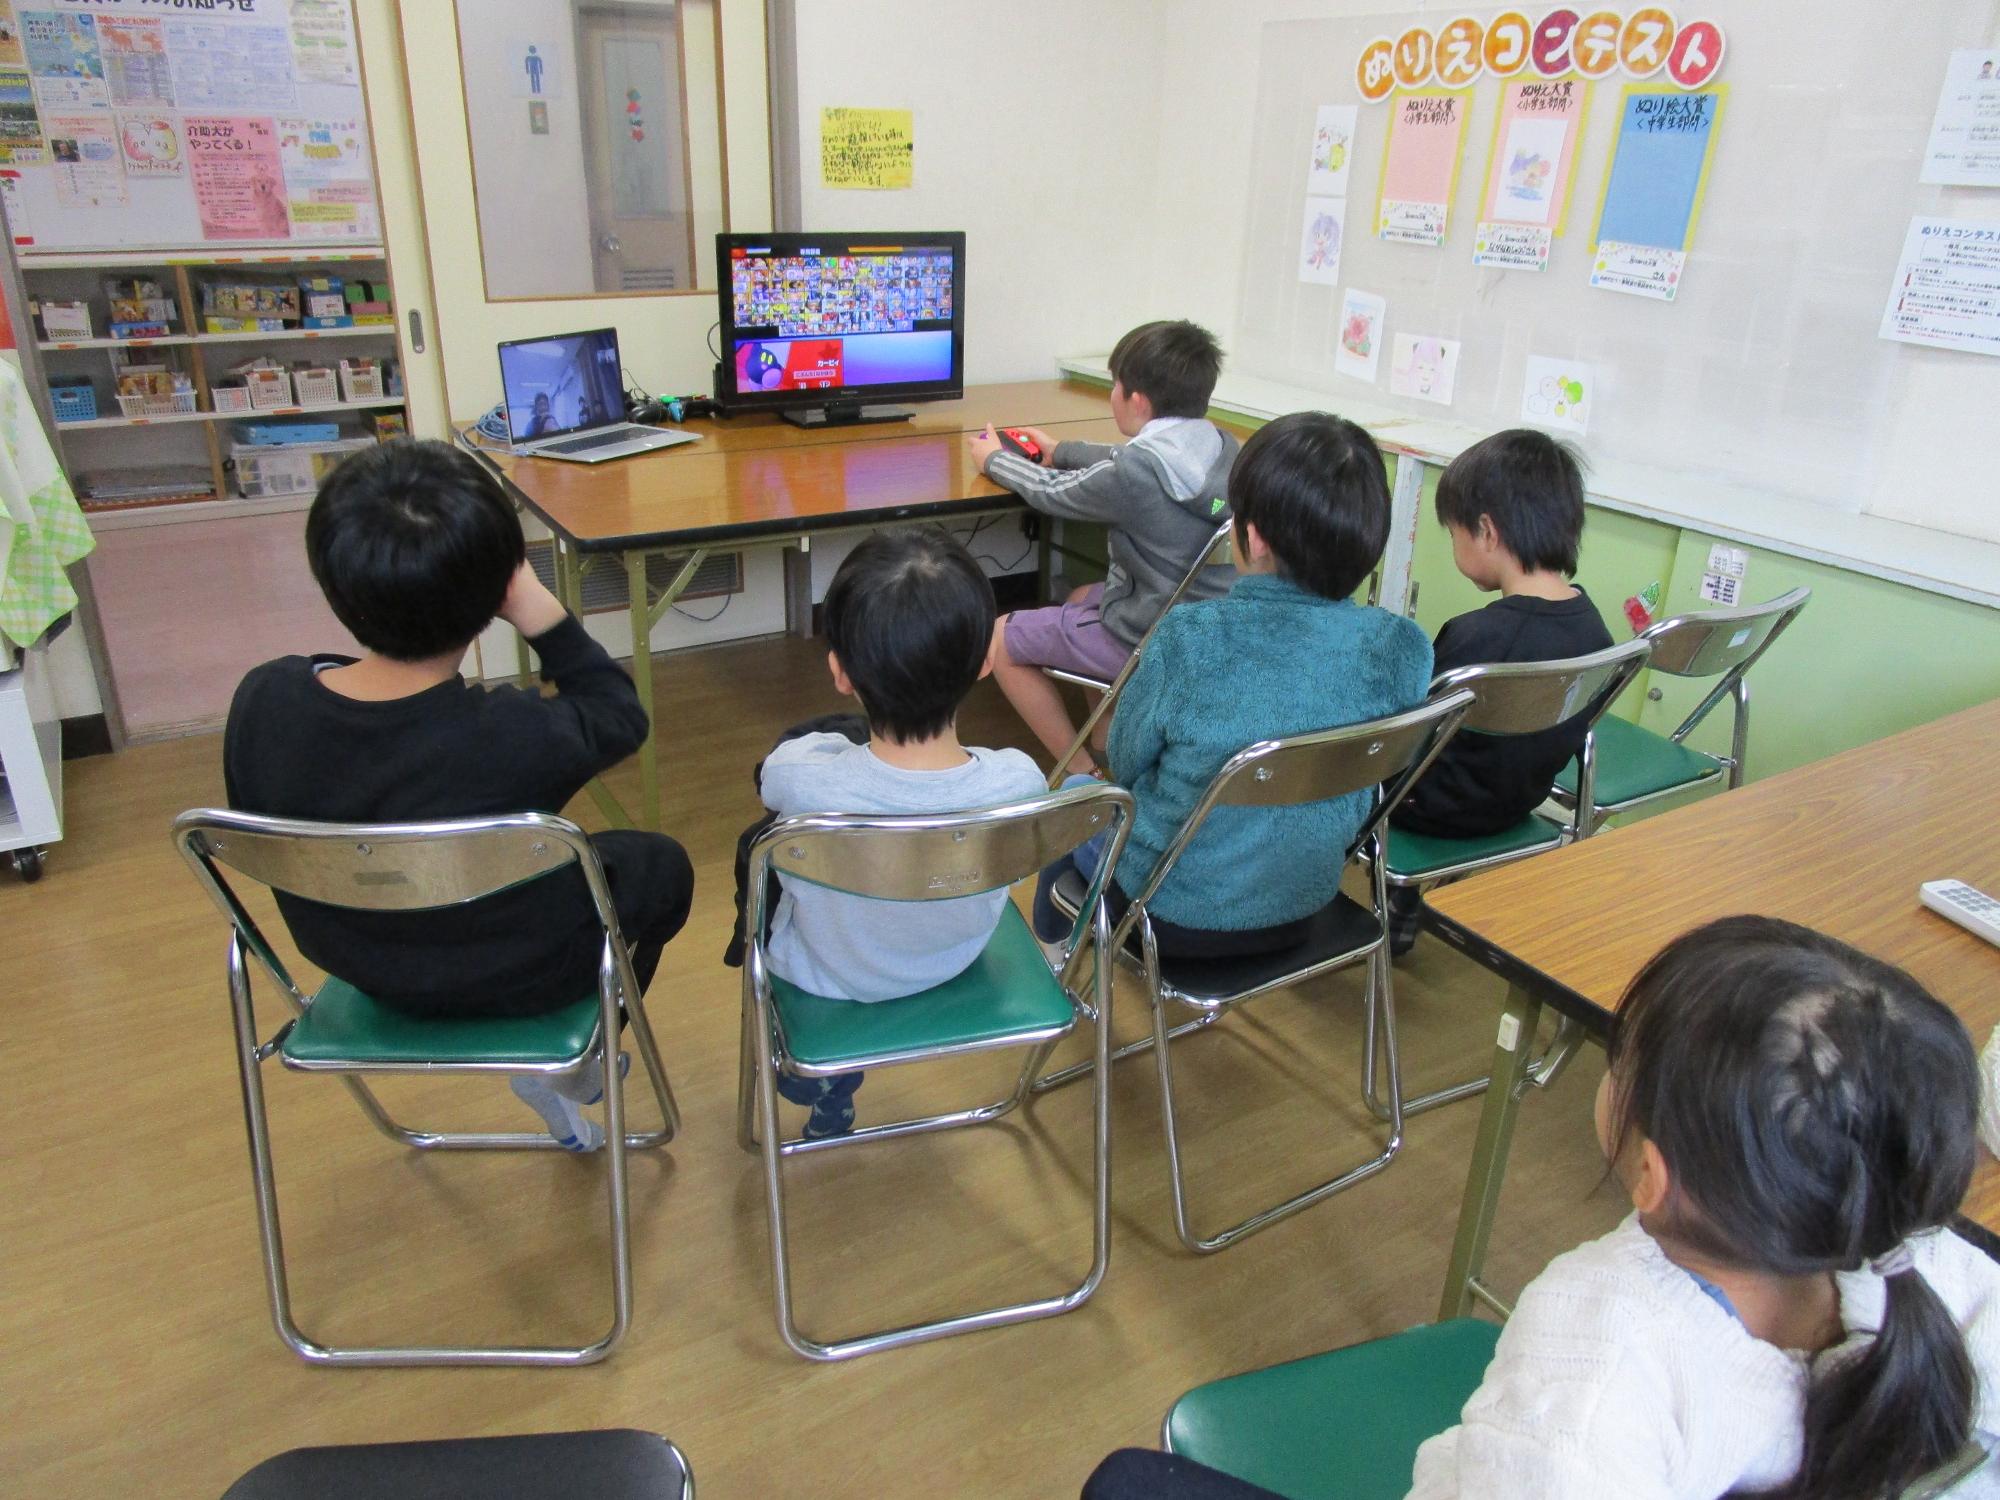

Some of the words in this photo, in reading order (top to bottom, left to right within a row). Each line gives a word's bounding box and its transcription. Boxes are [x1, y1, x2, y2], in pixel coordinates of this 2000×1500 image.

[1364, 21, 1707, 89] ぬりえコンテスト
[1635, 94, 1708, 117] ぬり絵大賞
[1652, 271, 1665, 281] さん
